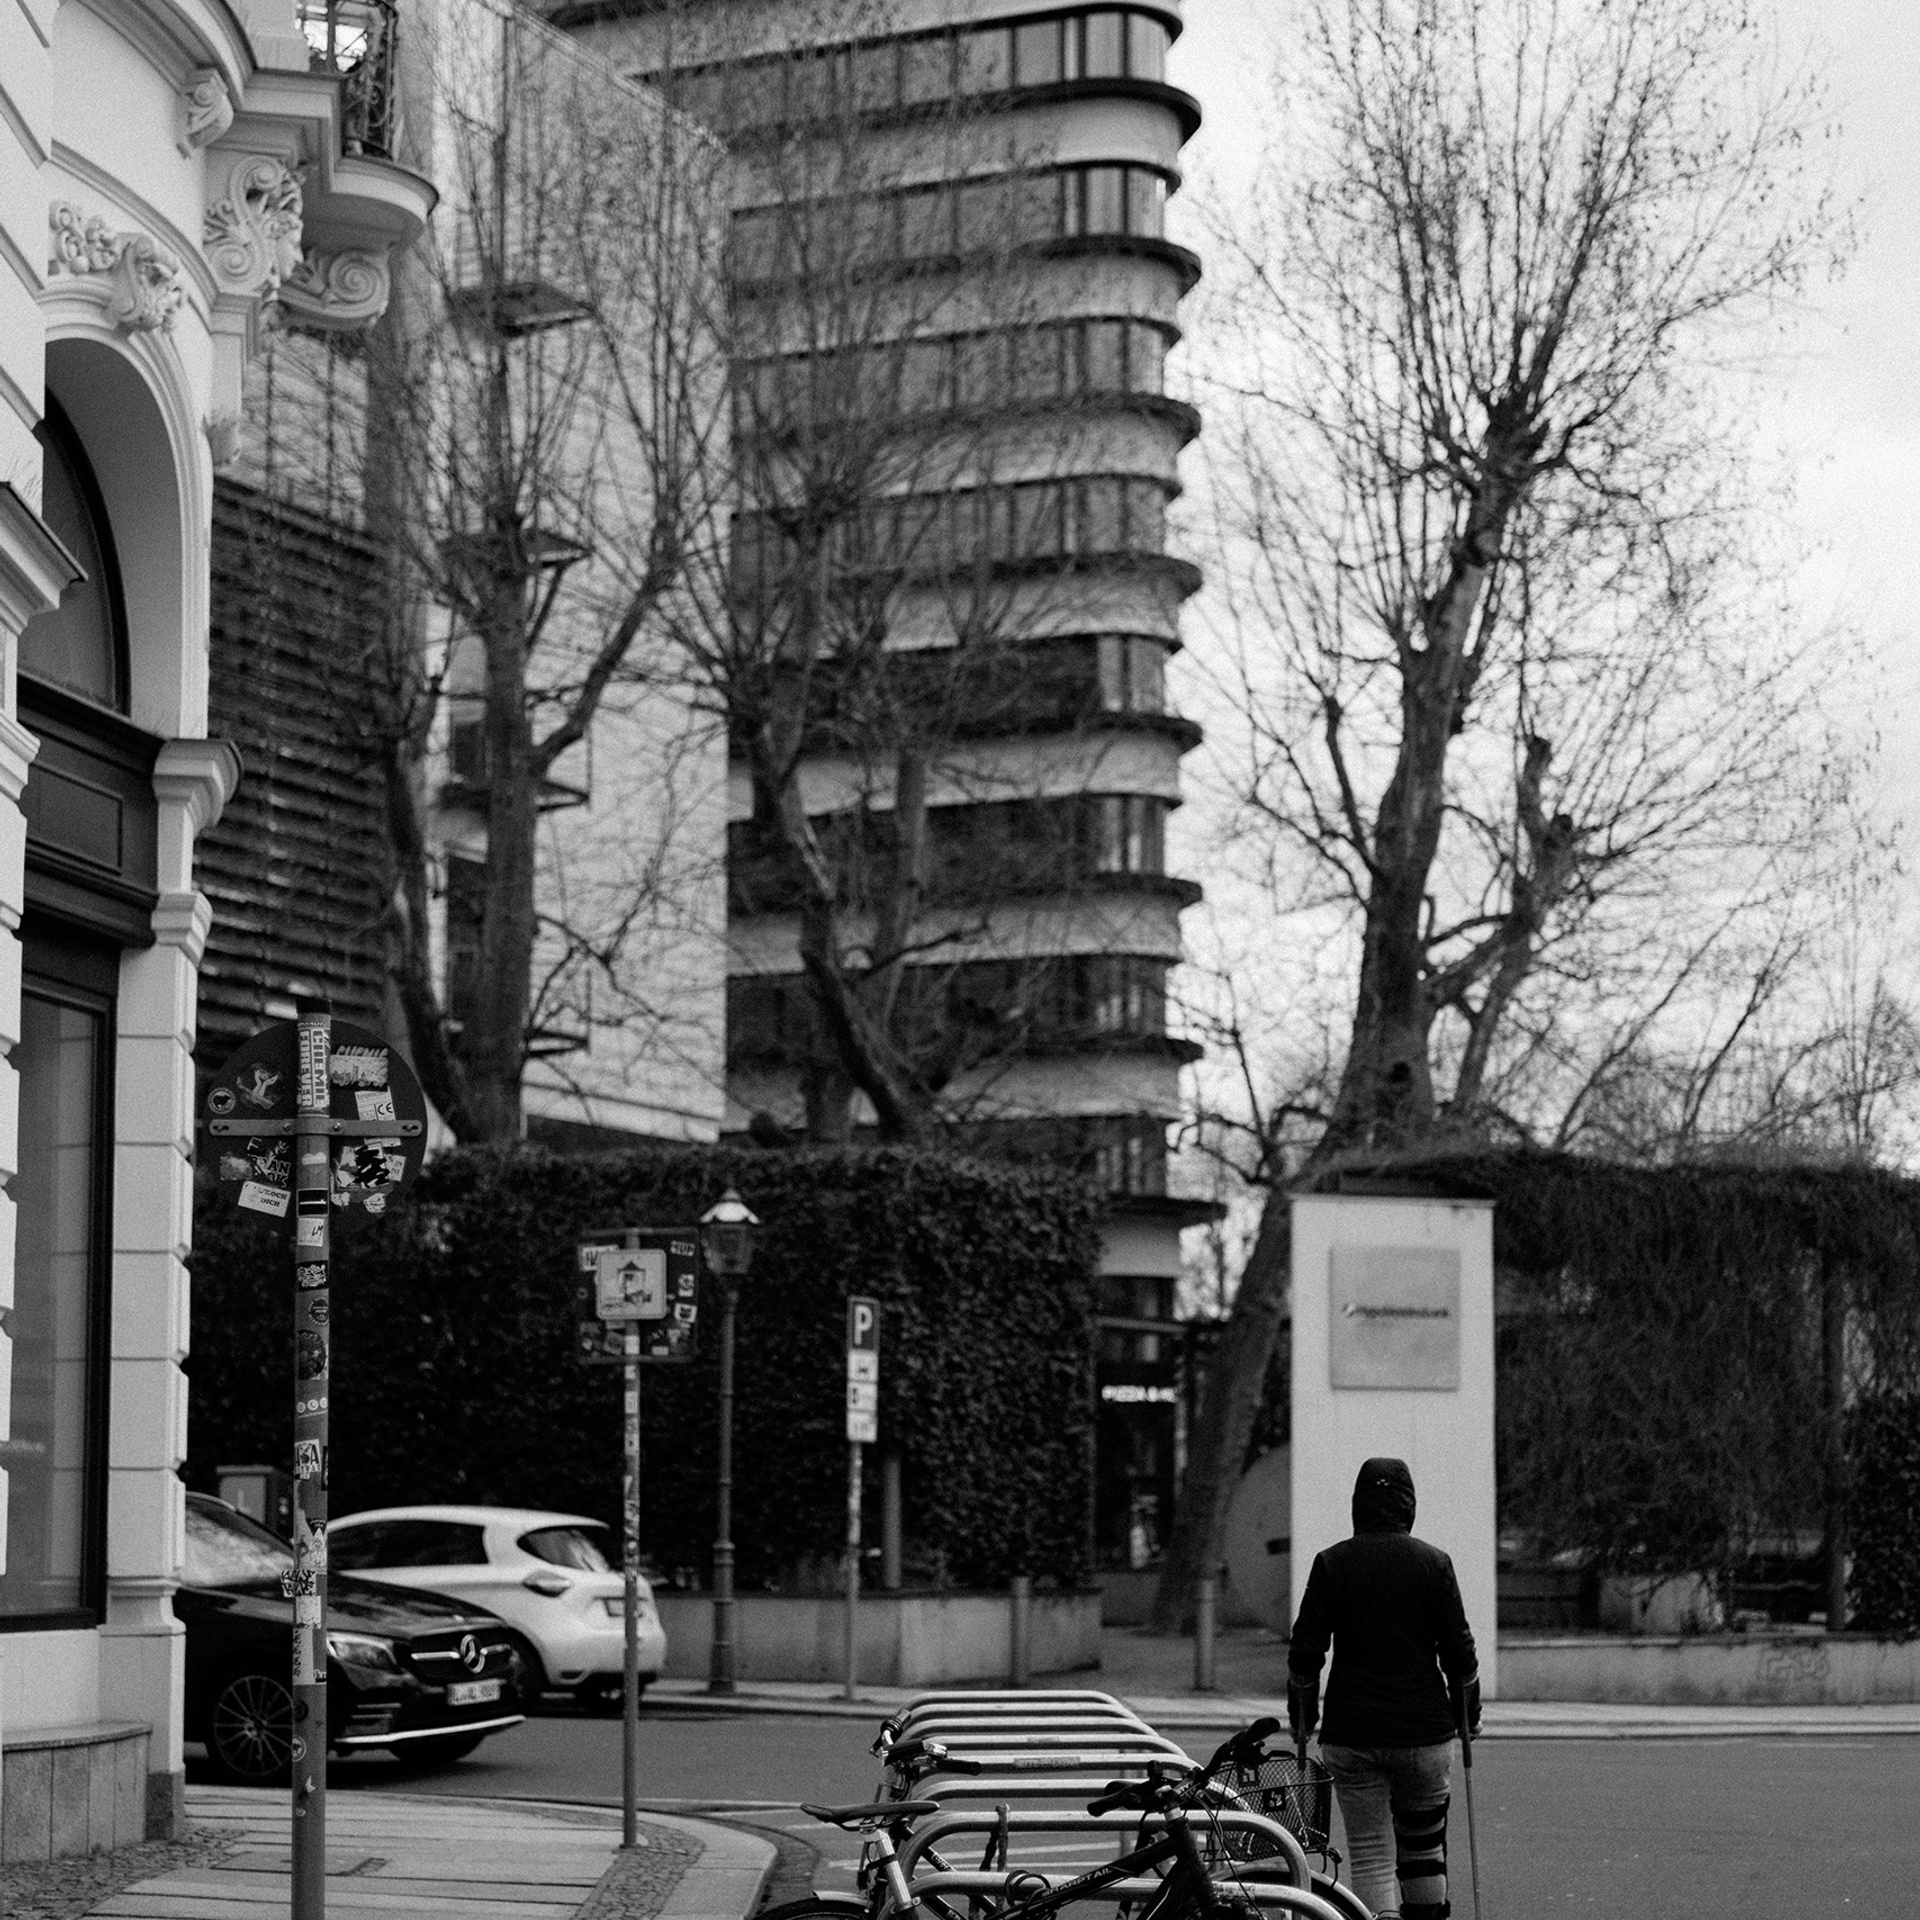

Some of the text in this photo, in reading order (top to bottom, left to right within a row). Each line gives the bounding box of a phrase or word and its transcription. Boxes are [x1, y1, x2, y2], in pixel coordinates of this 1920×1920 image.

[299, 1030, 313, 1107] FOREVER
[312, 1030, 326, 1106] CHEMIE
[854, 1304, 873, 1346] P
